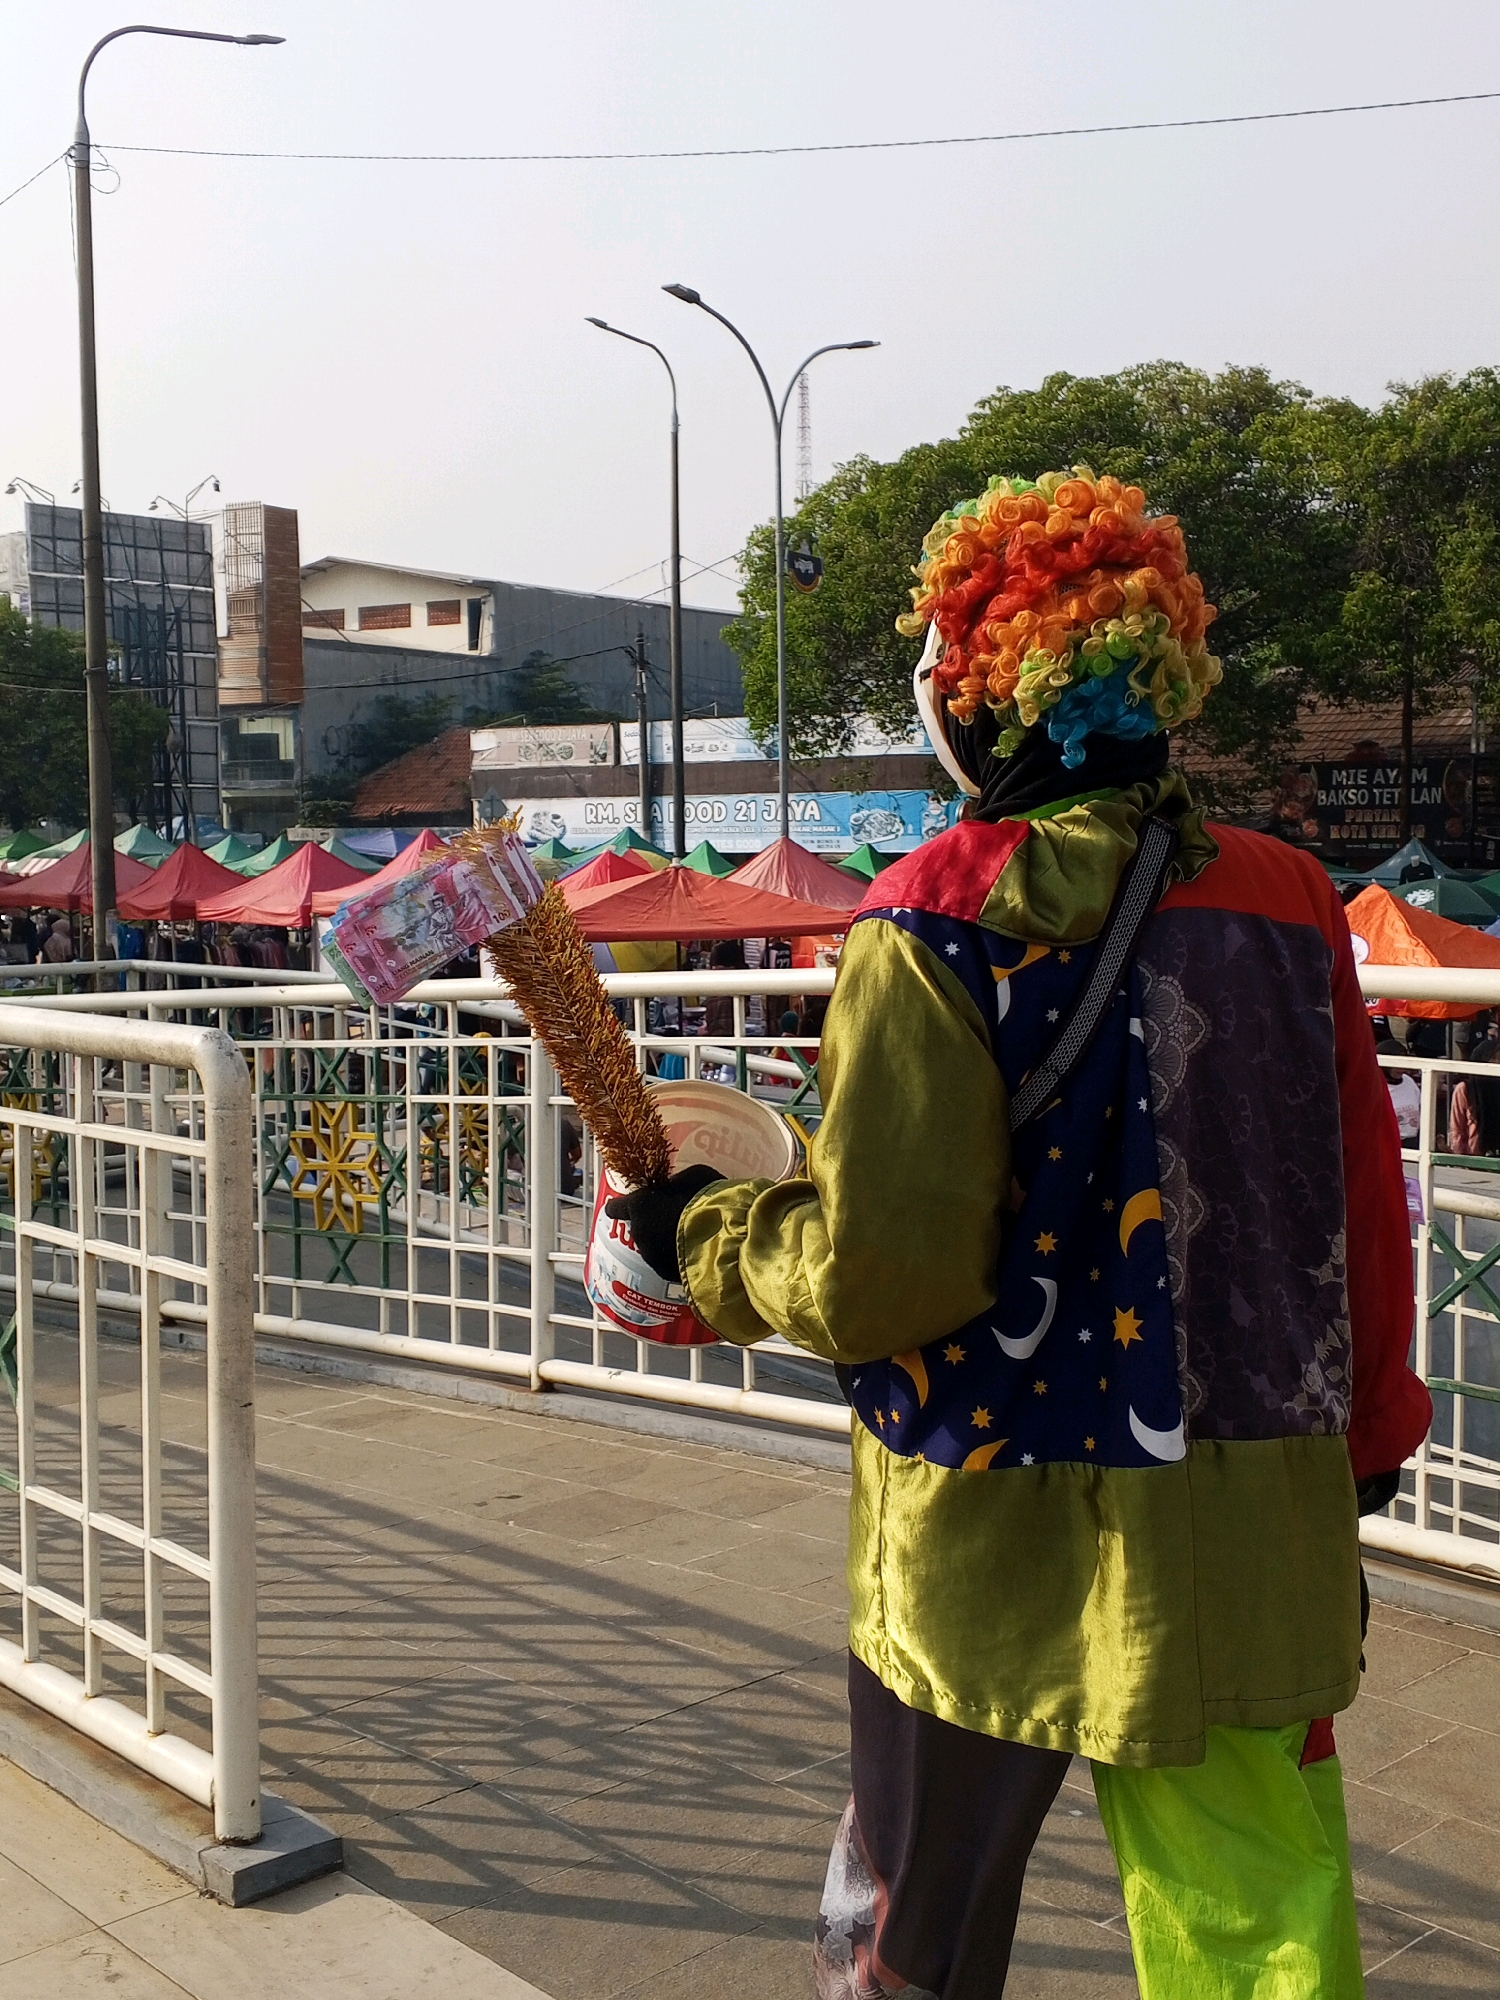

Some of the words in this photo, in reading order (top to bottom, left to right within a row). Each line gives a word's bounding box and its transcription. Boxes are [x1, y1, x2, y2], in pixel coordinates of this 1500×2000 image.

[558, 729, 566, 741] 21
[567, 728, 587, 741] JAYA
[1332, 769, 1368, 785] MIE
[1373, 767, 1428, 785] AYM
[1317, 788, 1369, 806] BAKSO
[1373, 787, 1442, 805] TETLAN
[585, 802, 621, 824] RM.
[734, 799, 757, 821] 21
[1344, 808, 1401, 823] PERTAM
[626, 1290, 642, 1302] CAT
[643, 1298, 679, 1312] TEMBOK
